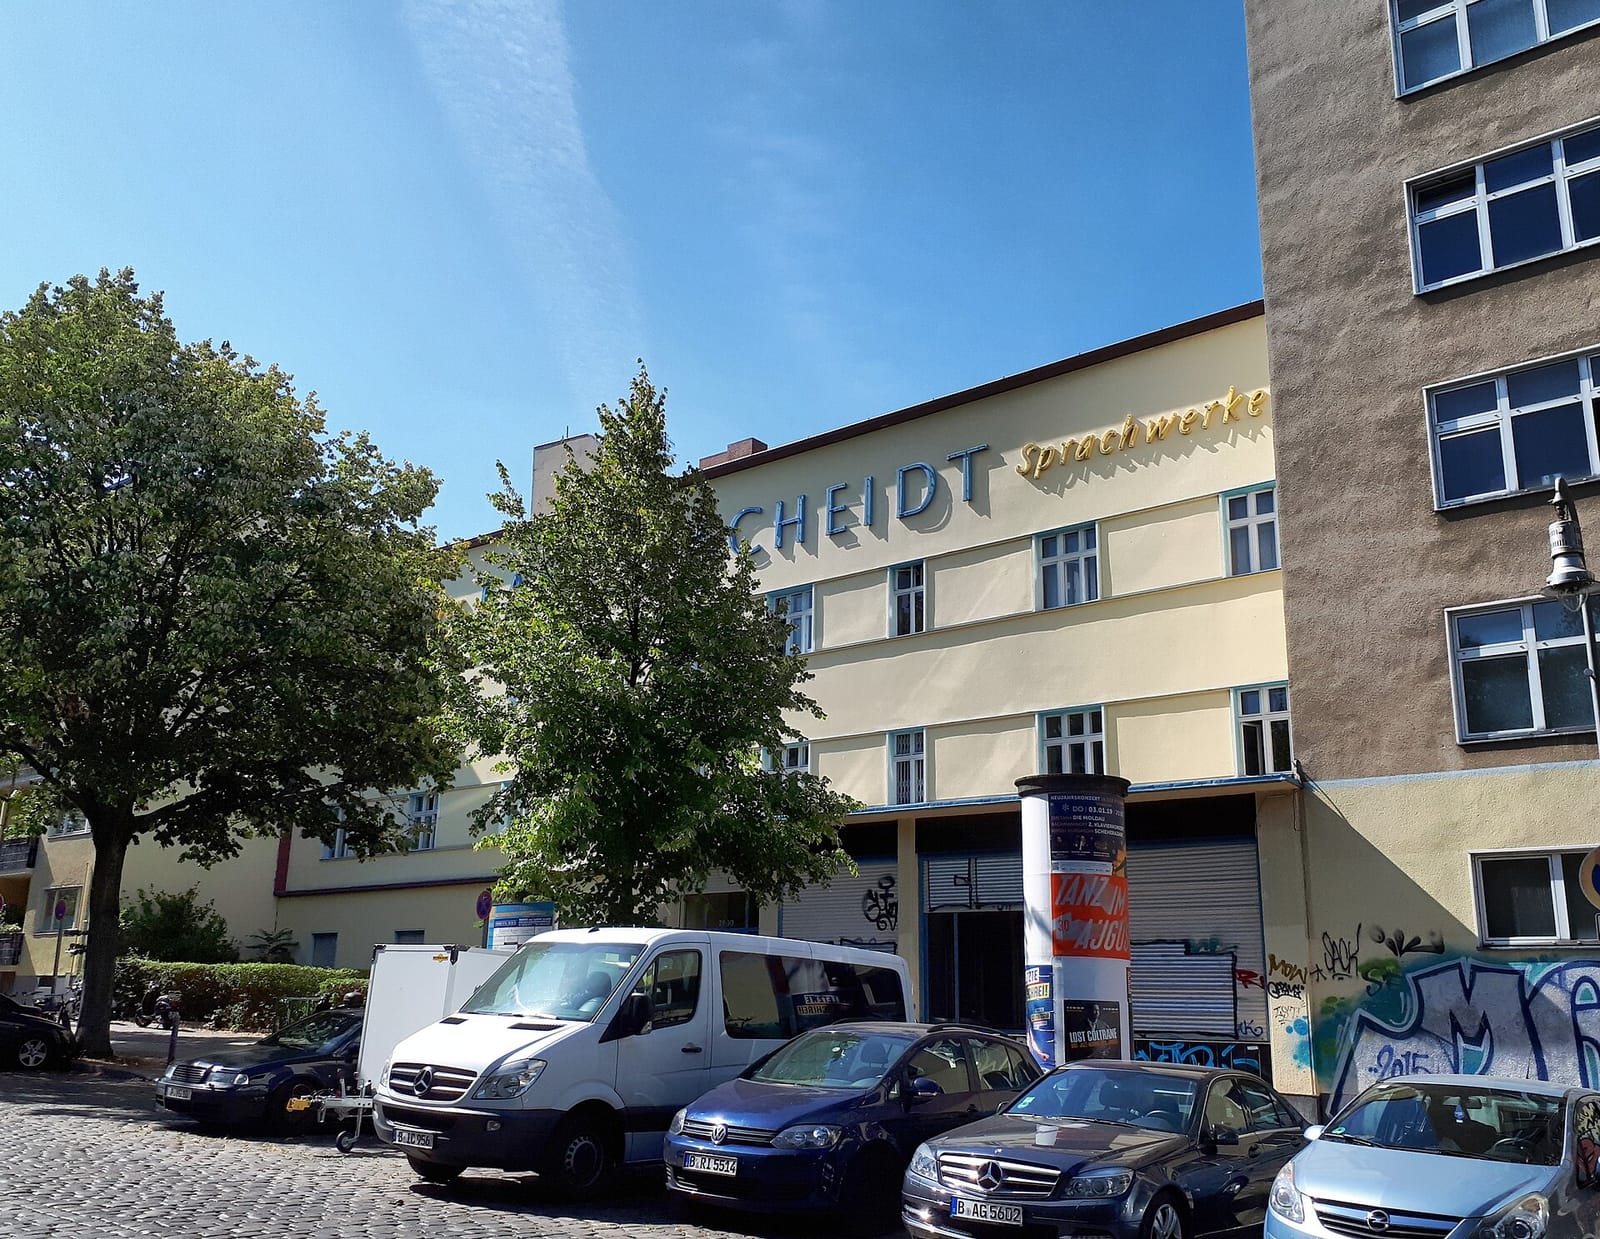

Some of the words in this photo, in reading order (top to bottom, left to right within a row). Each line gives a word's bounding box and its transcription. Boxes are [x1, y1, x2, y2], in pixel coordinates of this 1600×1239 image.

[1016, 385, 1267, 480] Sprachwerke
[1056, 875, 1110, 907] TANZ
[1113, 885, 1126, 917] IM
[1070, 1031, 1086, 1043] LOST
[1086, 1028, 1118, 1042] COLTRANE
[689, 1155, 696, 1168] B
[700, 1156, 712, 1170] RI
[713, 1159, 736, 1174] 5514
[958, 1200, 964, 1215] B
[972, 1204, 987, 1218] AG
[990, 1206, 1021, 1222] 5602
